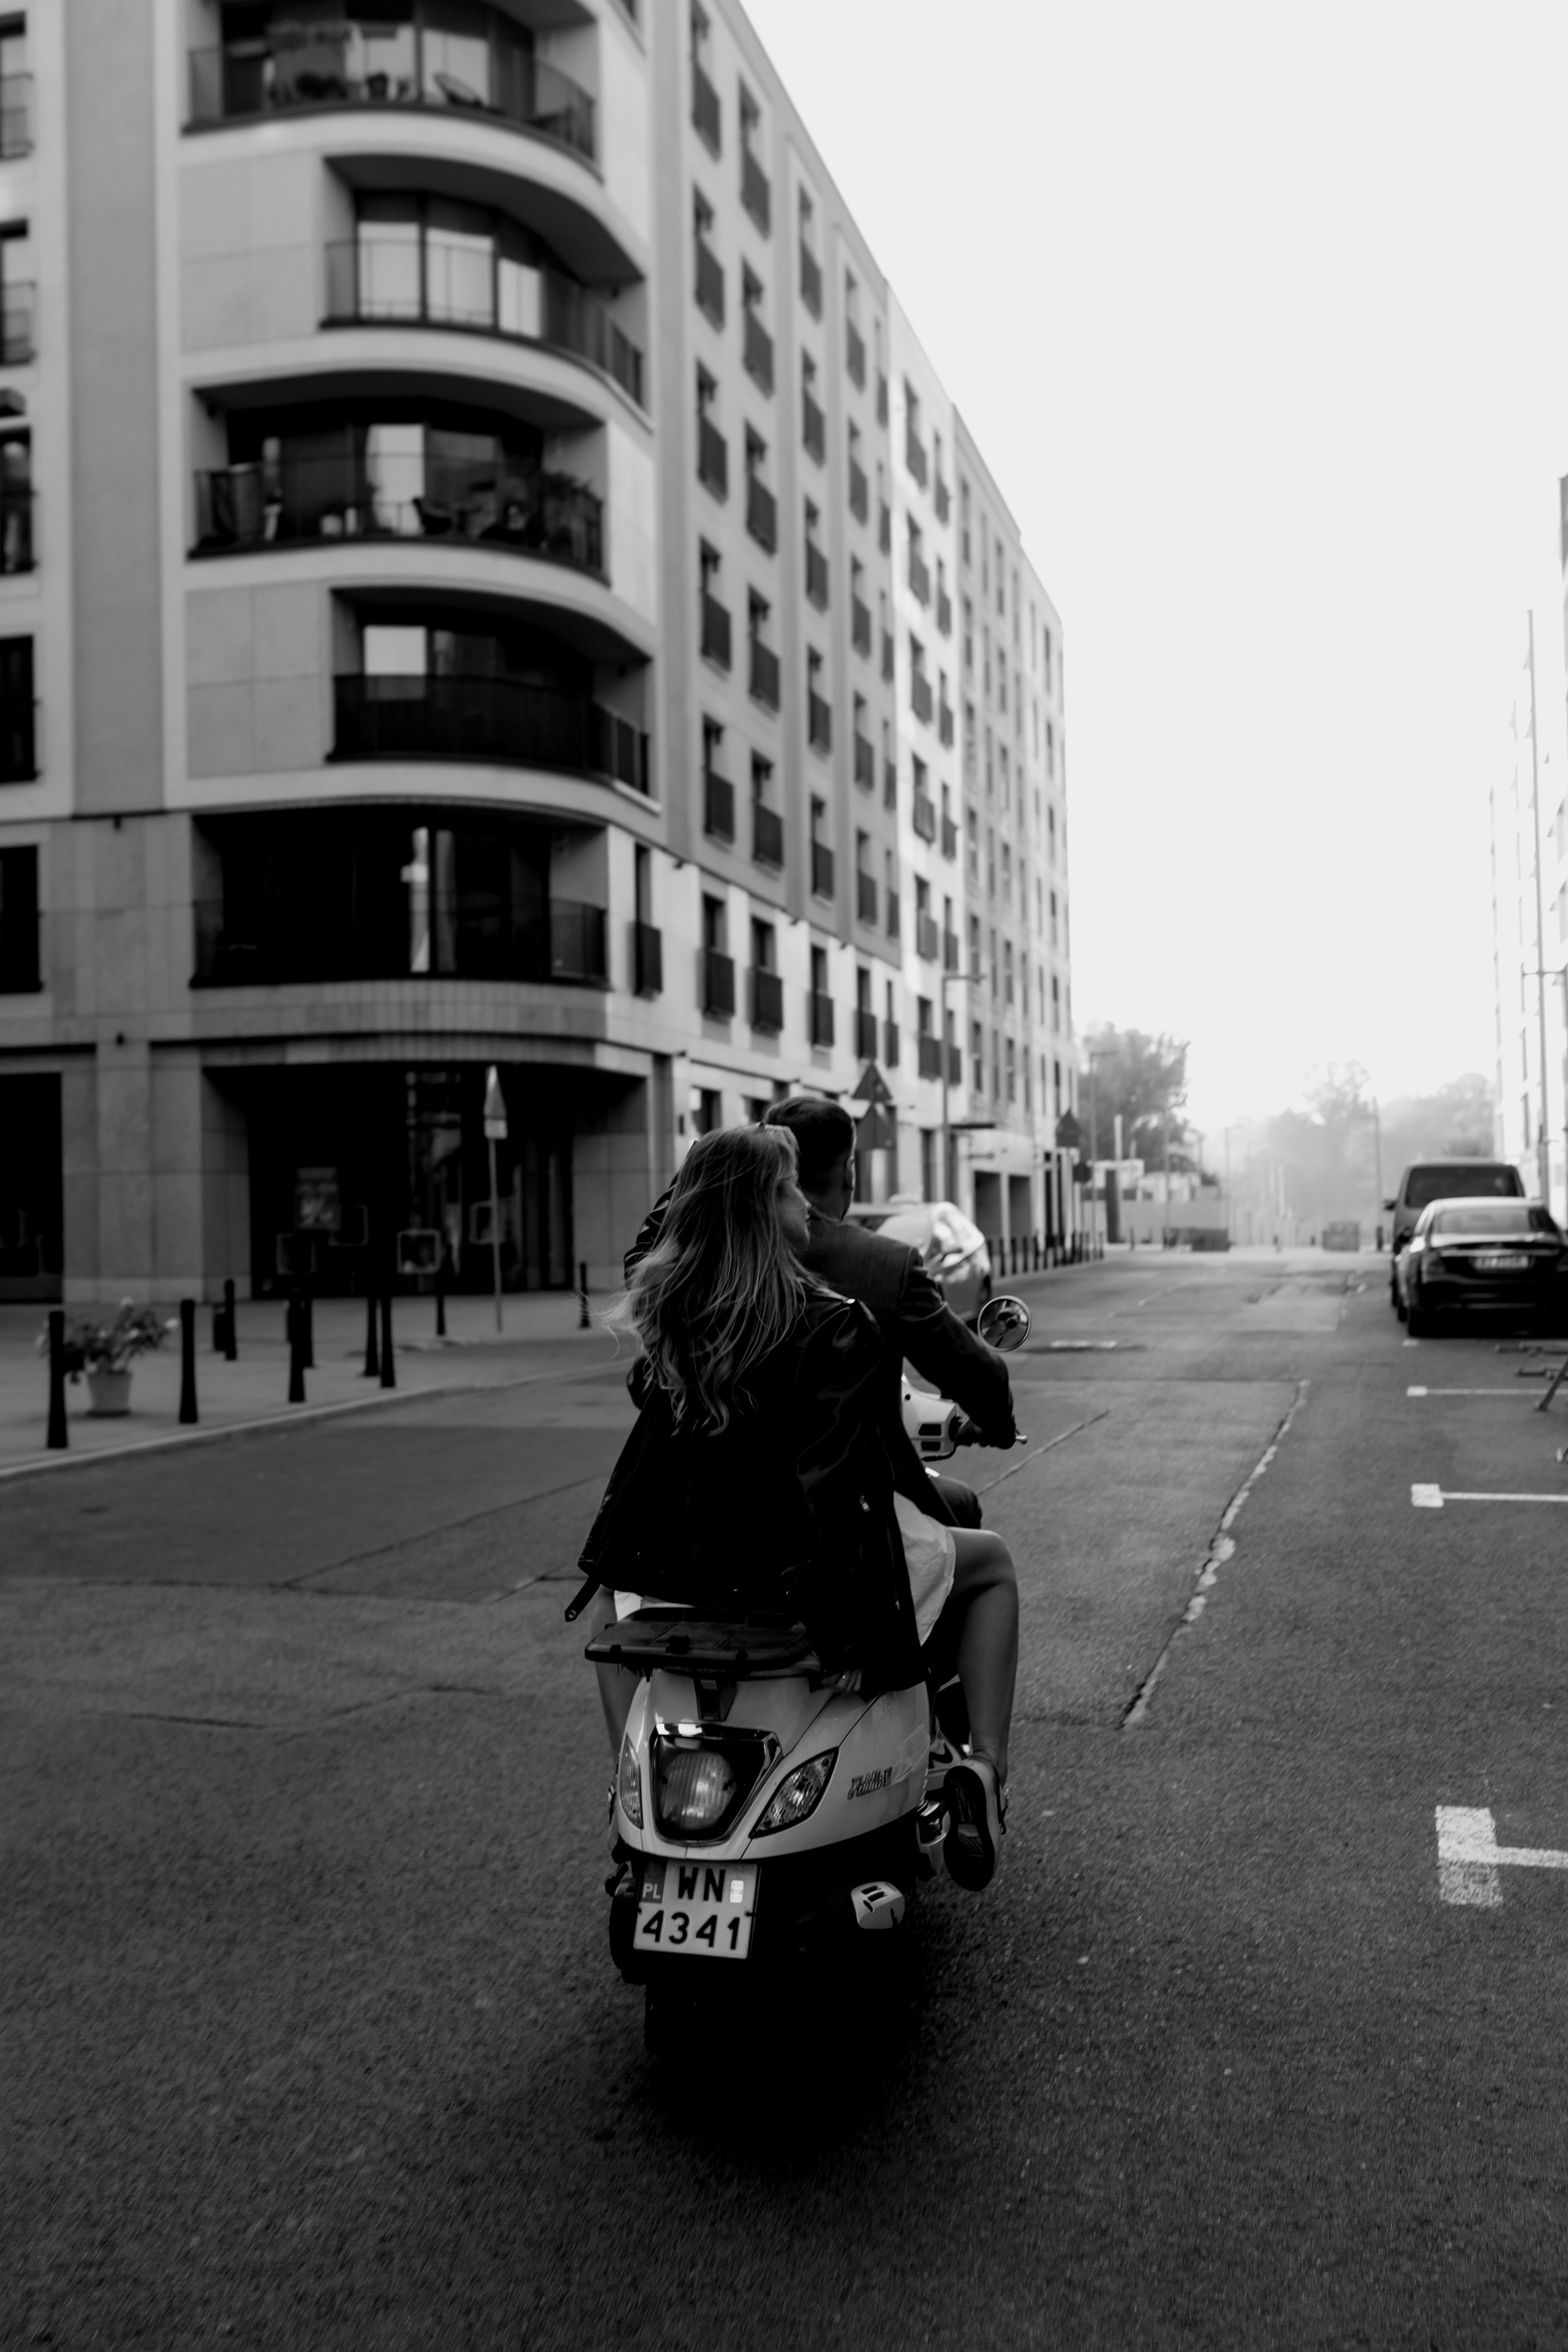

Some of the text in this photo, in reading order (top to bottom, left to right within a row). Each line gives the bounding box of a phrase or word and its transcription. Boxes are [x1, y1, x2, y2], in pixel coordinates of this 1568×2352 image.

[643, 1883, 661, 1899] PL
[678, 1866, 726, 1902] WN
[643, 1910, 741, 1951] 4341
